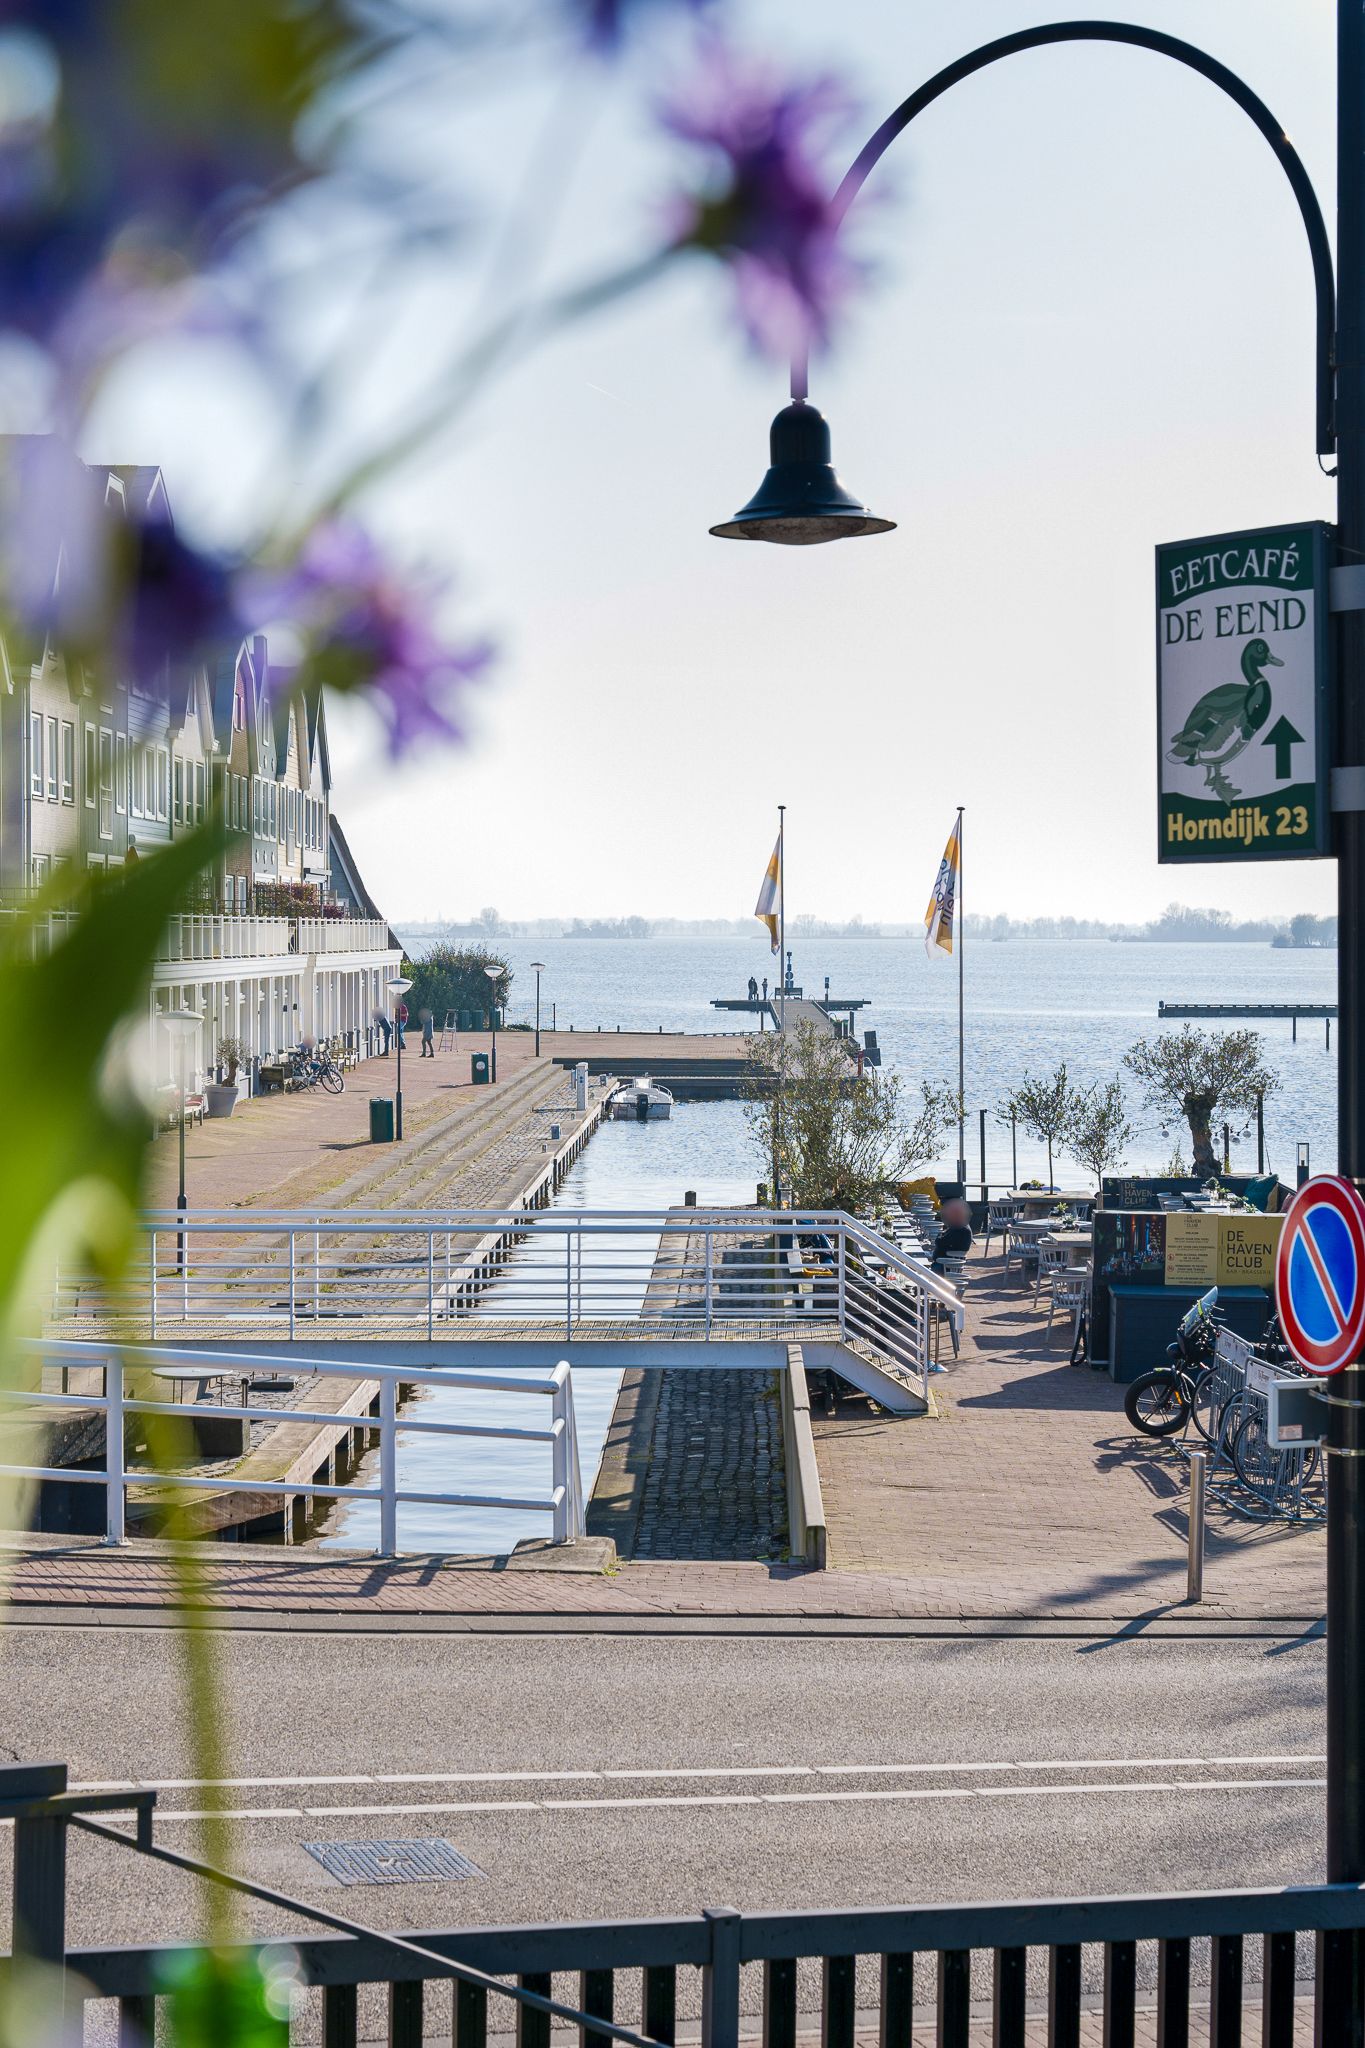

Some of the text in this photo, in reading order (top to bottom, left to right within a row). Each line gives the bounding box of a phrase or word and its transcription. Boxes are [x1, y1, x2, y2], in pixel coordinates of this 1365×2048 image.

[1169, 541, 1300, 597] EETCAFÉ
[1165, 597, 1306, 645] DE EEND
[1167, 805, 1309, 846] Horndijk 23
[1124, 1181, 1137, 1189] DE
[1124, 1189, 1153, 1198] HAVEN
[1227, 1230, 1245, 1242] DE
[1226, 1243, 1272, 1255] HAVEN
[1226, 1256, 1263, 1268] CLUB
